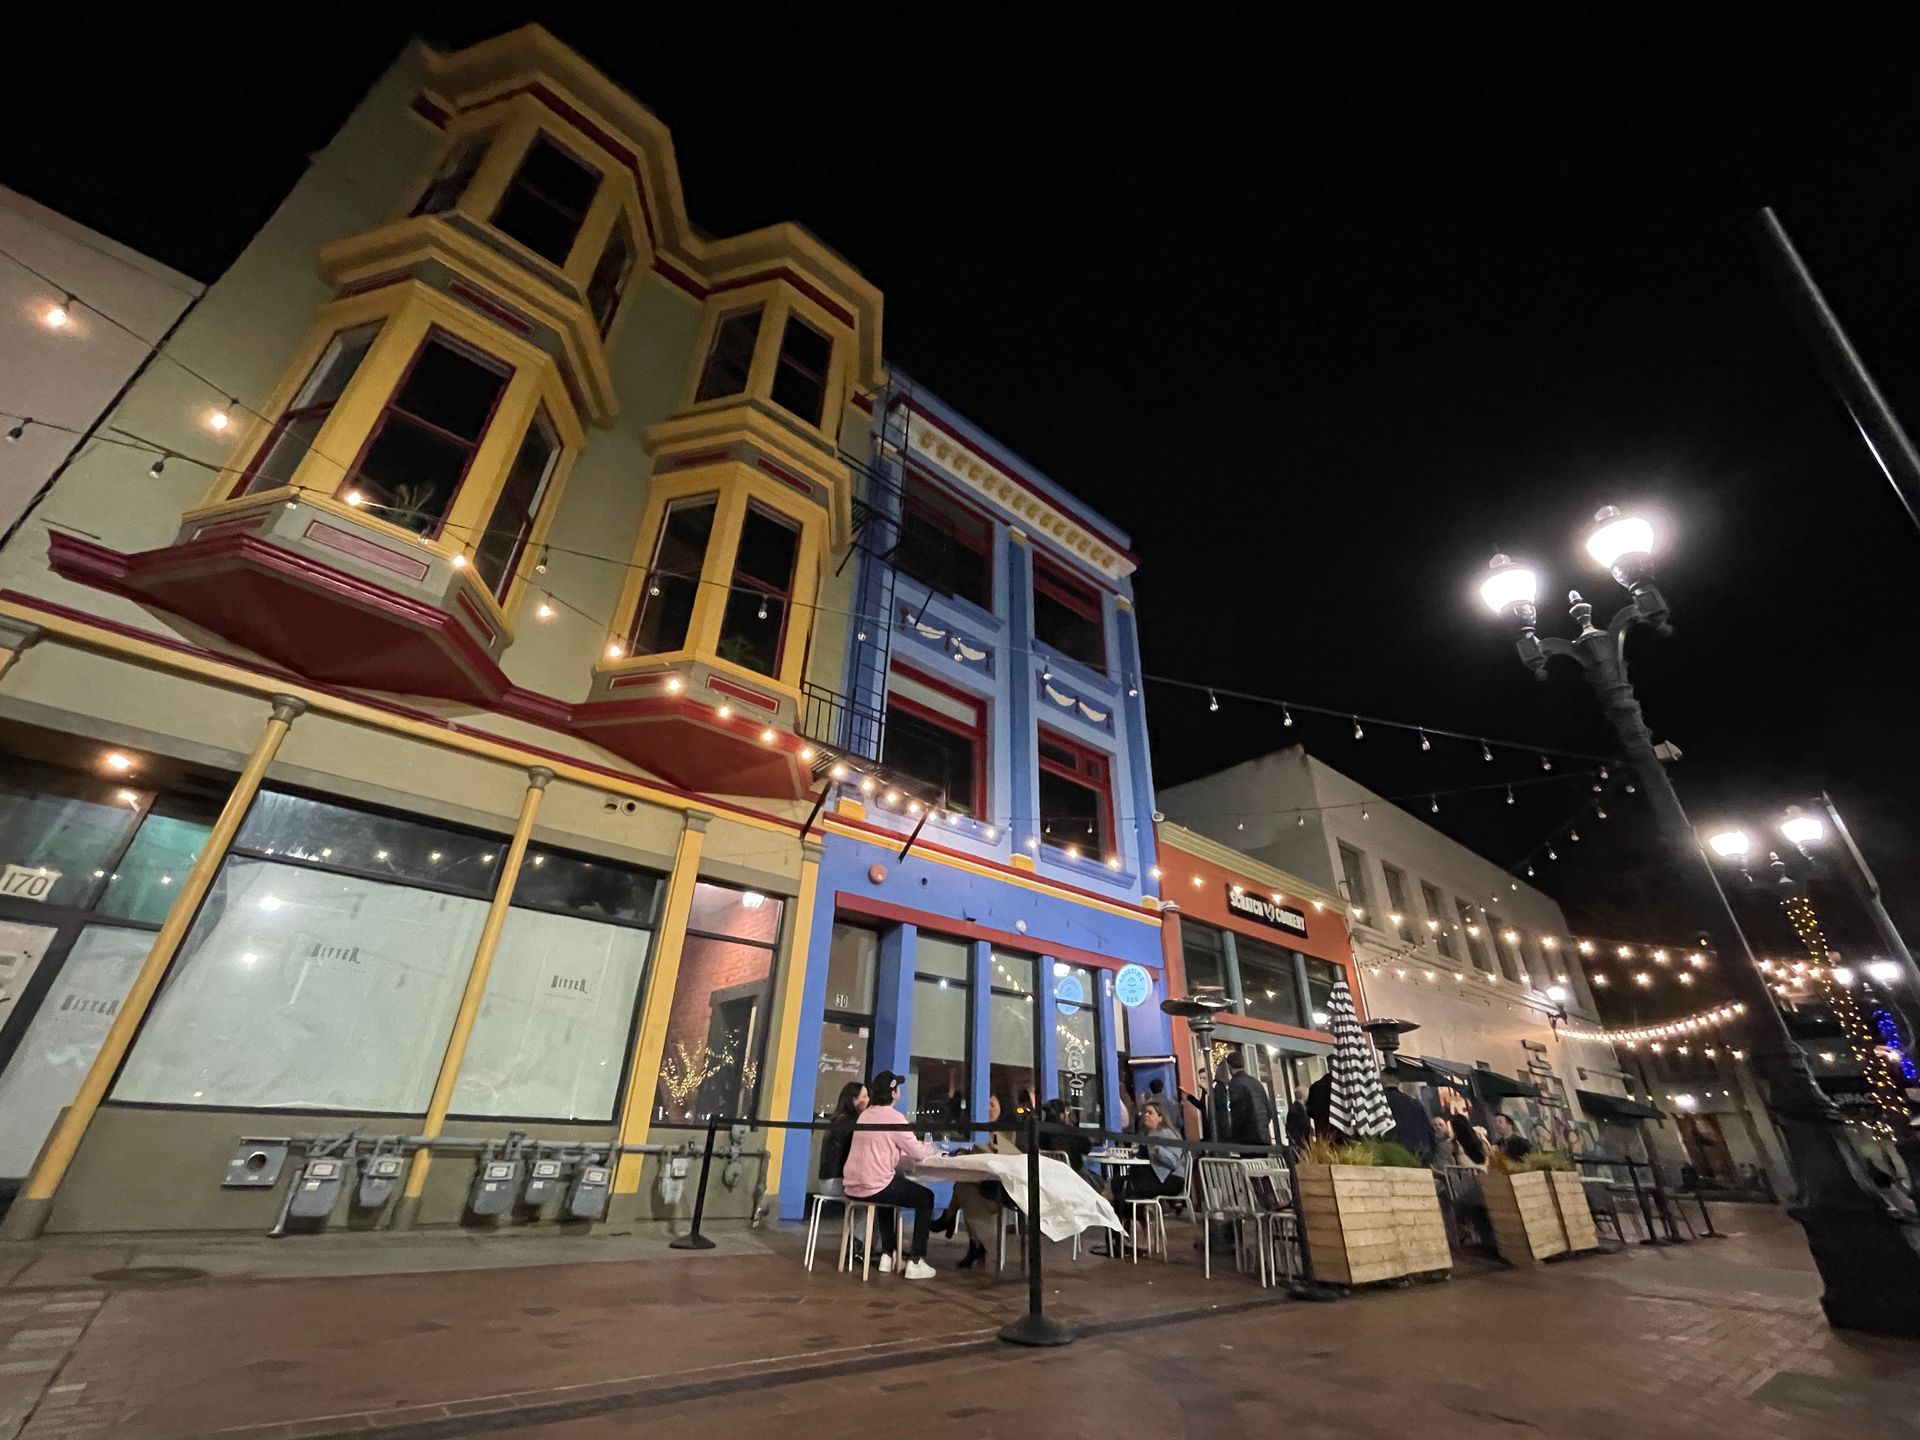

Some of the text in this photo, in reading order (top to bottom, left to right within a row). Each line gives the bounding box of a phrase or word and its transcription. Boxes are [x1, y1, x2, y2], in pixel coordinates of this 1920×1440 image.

[3, 872, 49, 897] 170
[550, 974, 588, 994] BITTER
[836, 994, 848, 1007] 30
